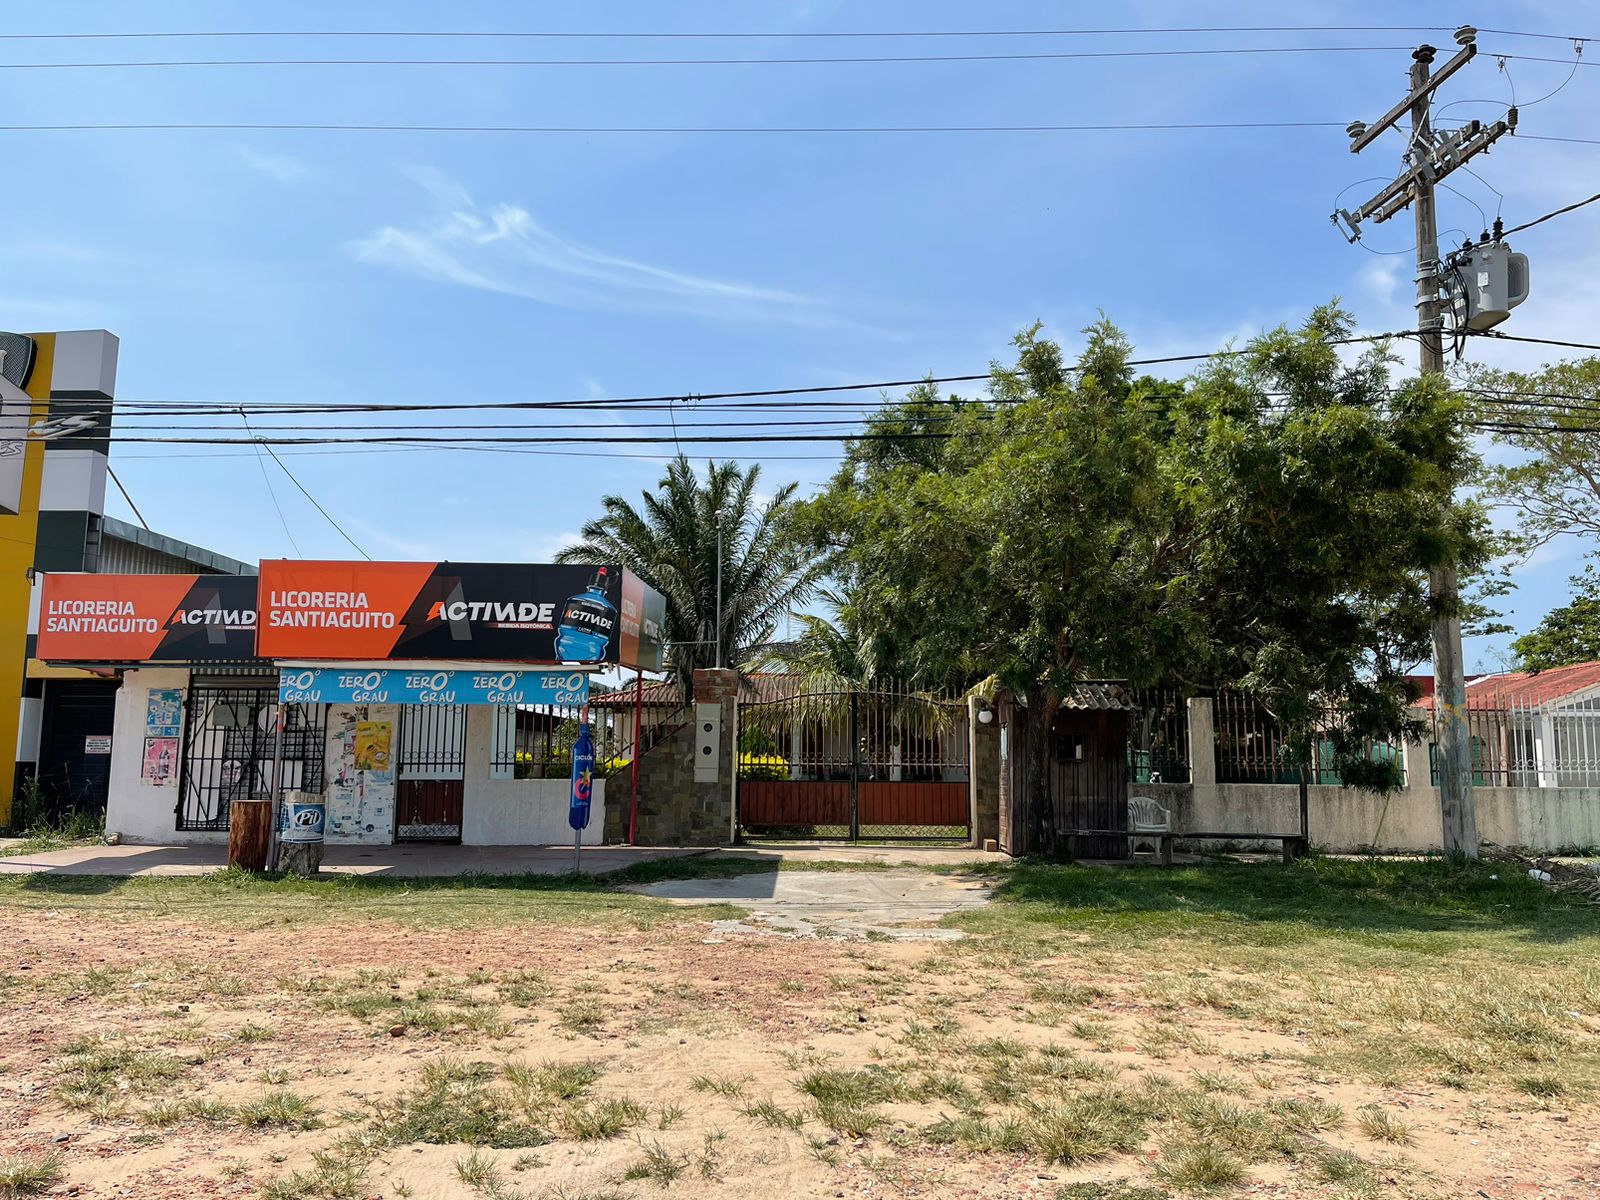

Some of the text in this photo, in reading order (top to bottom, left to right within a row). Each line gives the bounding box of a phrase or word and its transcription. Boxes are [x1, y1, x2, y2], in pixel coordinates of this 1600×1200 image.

[270, 591, 368, 608] LICORERIA
[48, 600, 135, 615] LICORERIA
[171, 609, 257, 625] ACTIVAD
[269, 610, 395, 628] SANTIAGUITO
[47, 617, 158, 633] SANTIAGUITO
[285, 690, 321, 702] GRAU
[352, 690, 388, 702] GRAU
[420, 691, 456, 702] GRAU
[487, 691, 523, 703] GRAU
[555, 691, 588, 703] GRAU
[299, 811, 318, 824] Pil
